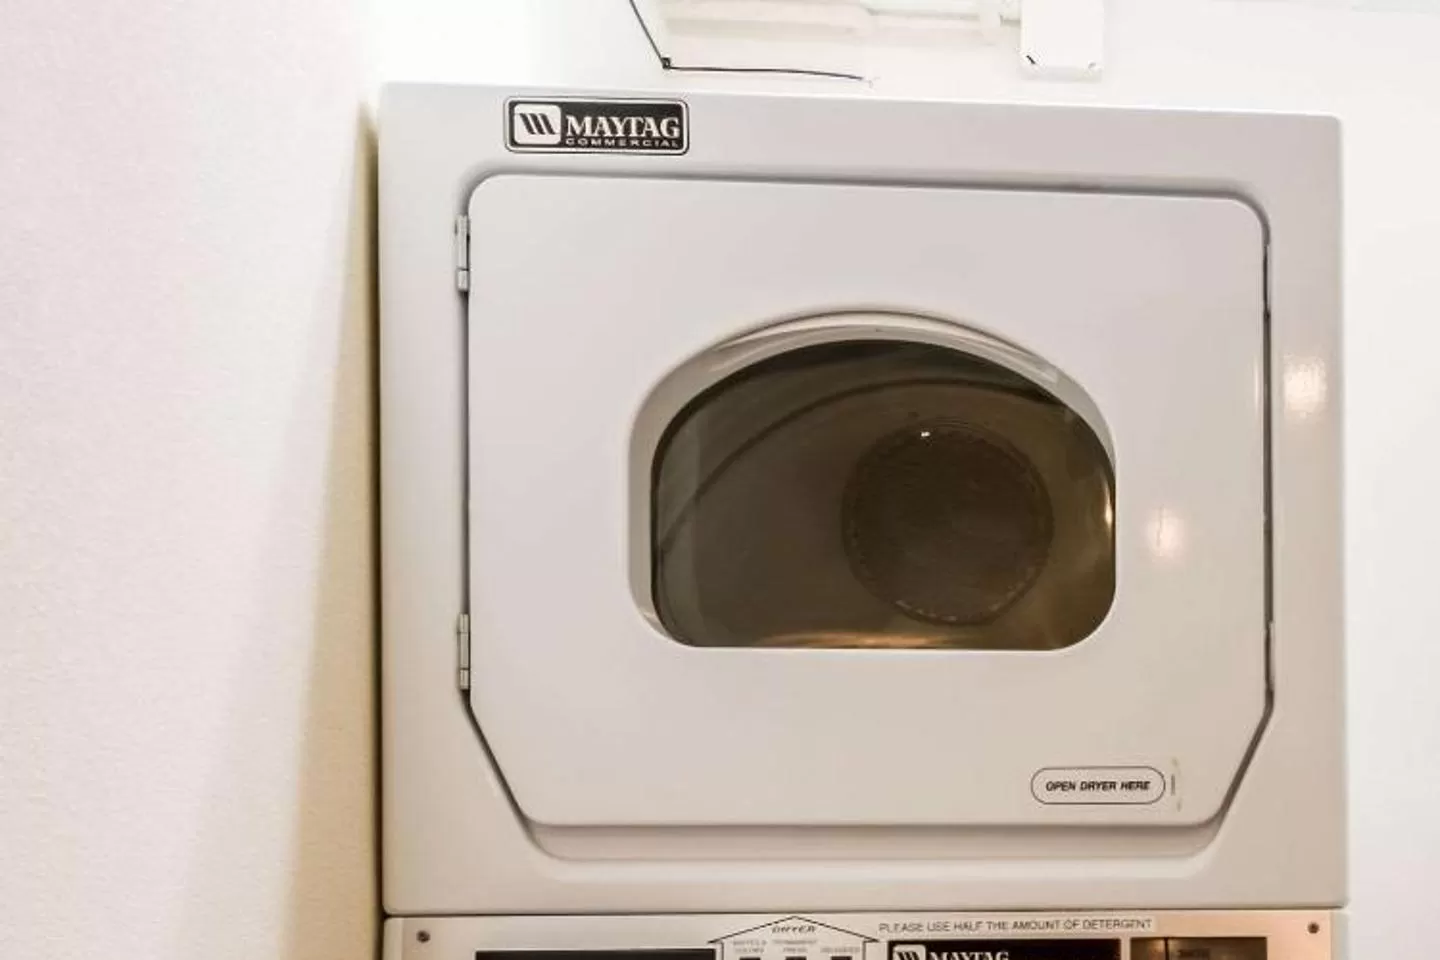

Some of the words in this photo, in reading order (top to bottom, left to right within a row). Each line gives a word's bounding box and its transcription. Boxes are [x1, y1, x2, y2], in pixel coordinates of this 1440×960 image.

[565, 115, 680, 139] MAYTAG
[565, 138, 679, 148] COMMERCIAL
[1045, 780, 1076, 792] OPEN
[1080, 780, 1117, 791] DRYER
[1120, 780, 1151, 791] HERE
[879, 922, 924, 932] PLEASE
[927, 921, 951, 932] USE
[954, 920, 983, 931] HALF
[985, 920, 1008, 930] THE
[1011, 920, 1060, 930] AMOUNT
[1063, 919, 1080, 930] OF
[1082, 918, 1153, 930] DETERGENT
